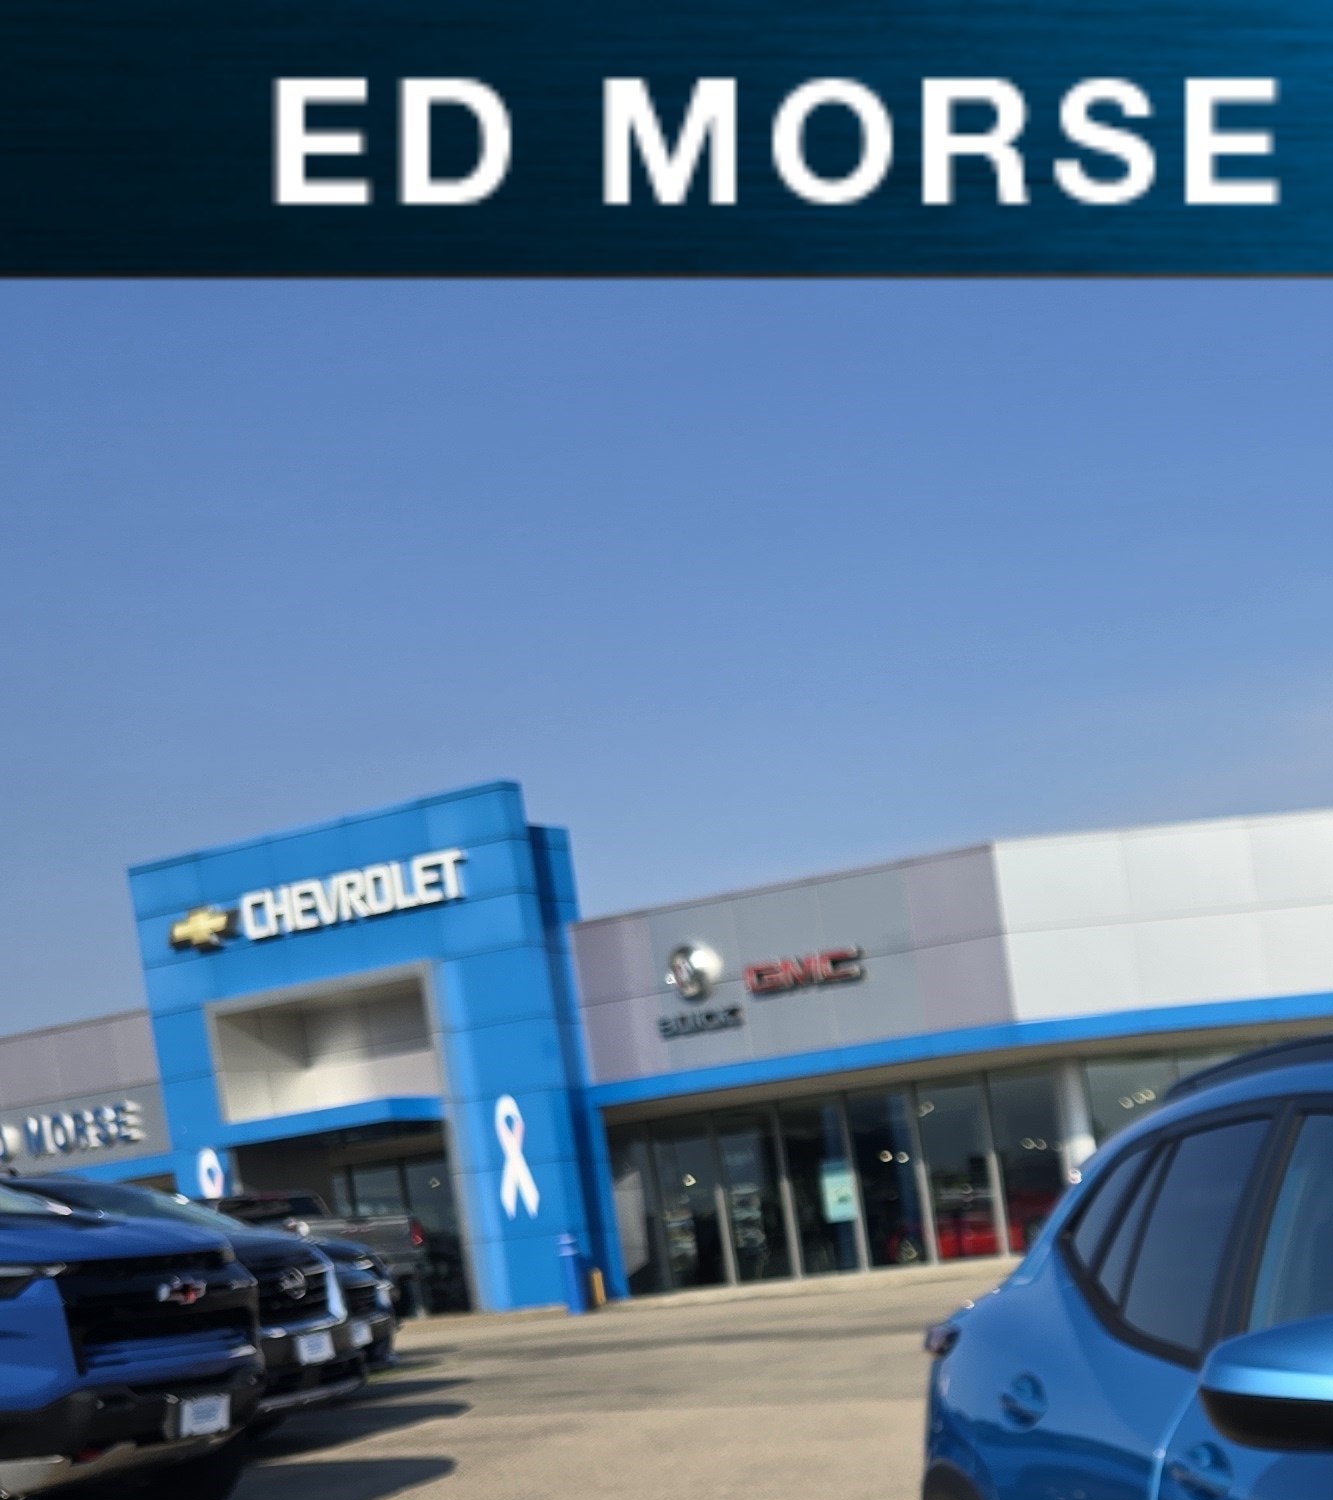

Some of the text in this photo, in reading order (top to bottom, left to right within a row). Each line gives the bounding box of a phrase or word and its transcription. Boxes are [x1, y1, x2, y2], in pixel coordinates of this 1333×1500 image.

[239, 848, 465, 941] CHEVROLET
[744, 946, 866, 997] GMC
[22, 1099, 145, 1158] MORSE
